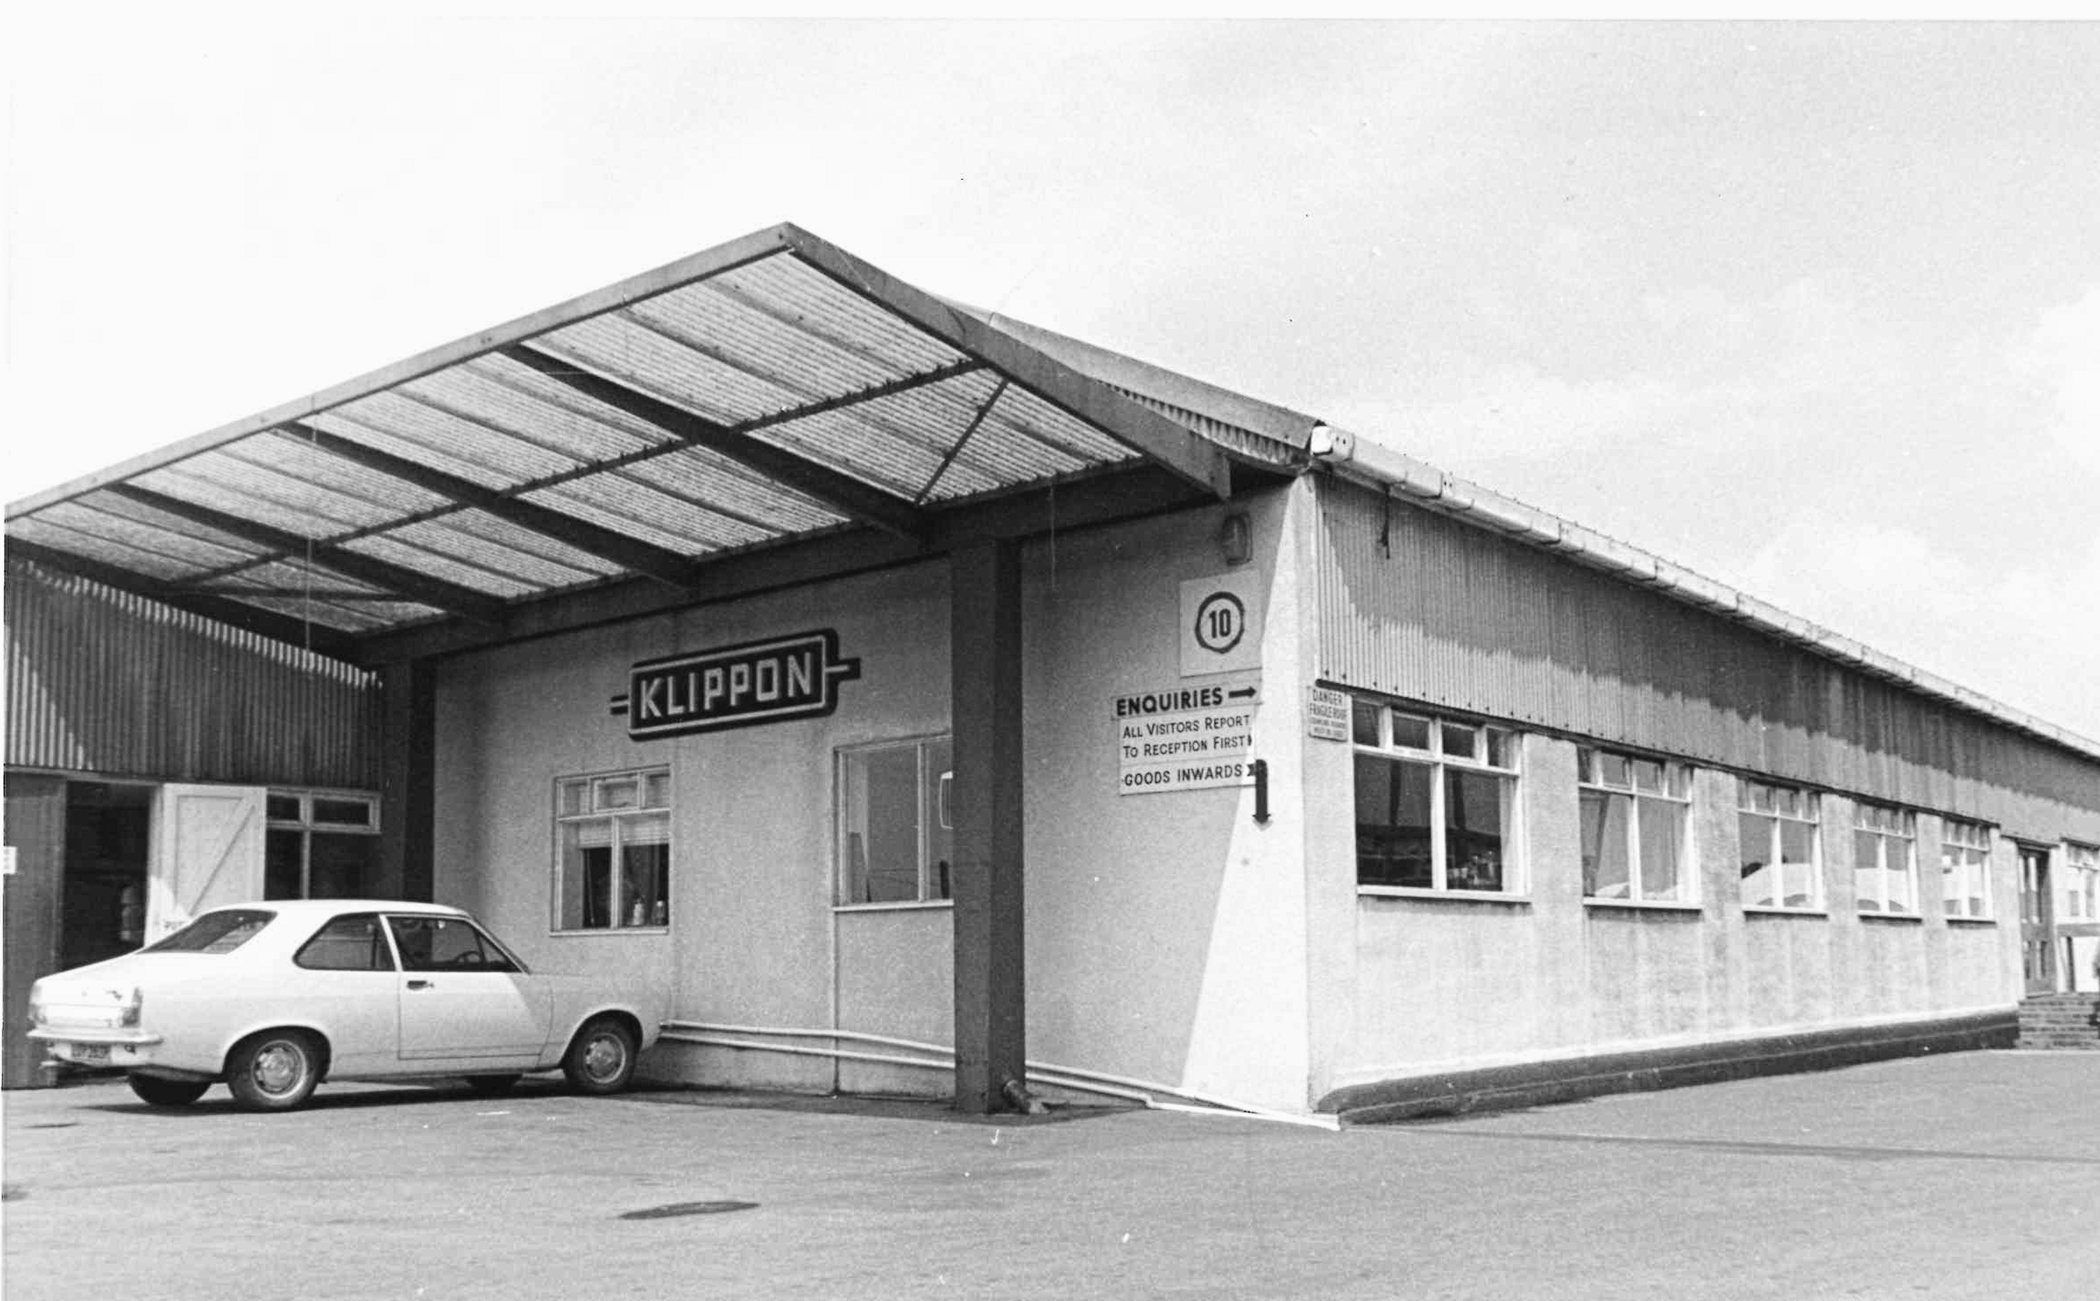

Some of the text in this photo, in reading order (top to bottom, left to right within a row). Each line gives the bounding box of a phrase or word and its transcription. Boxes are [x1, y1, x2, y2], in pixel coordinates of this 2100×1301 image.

[1209, 608, 1231, 639] 10
[640, 652, 812, 720] KLIPPON
[1313, 689, 1343, 706] DANGER
[1116, 687, 1223, 717] ENQUIRIES
[1123, 714, 1250, 739] ALL VISITORS REPORT
[1123, 735, 1245, 759] TO RECEPTION FIRST
[1124, 763, 1242, 787] GOODS INWARDS
